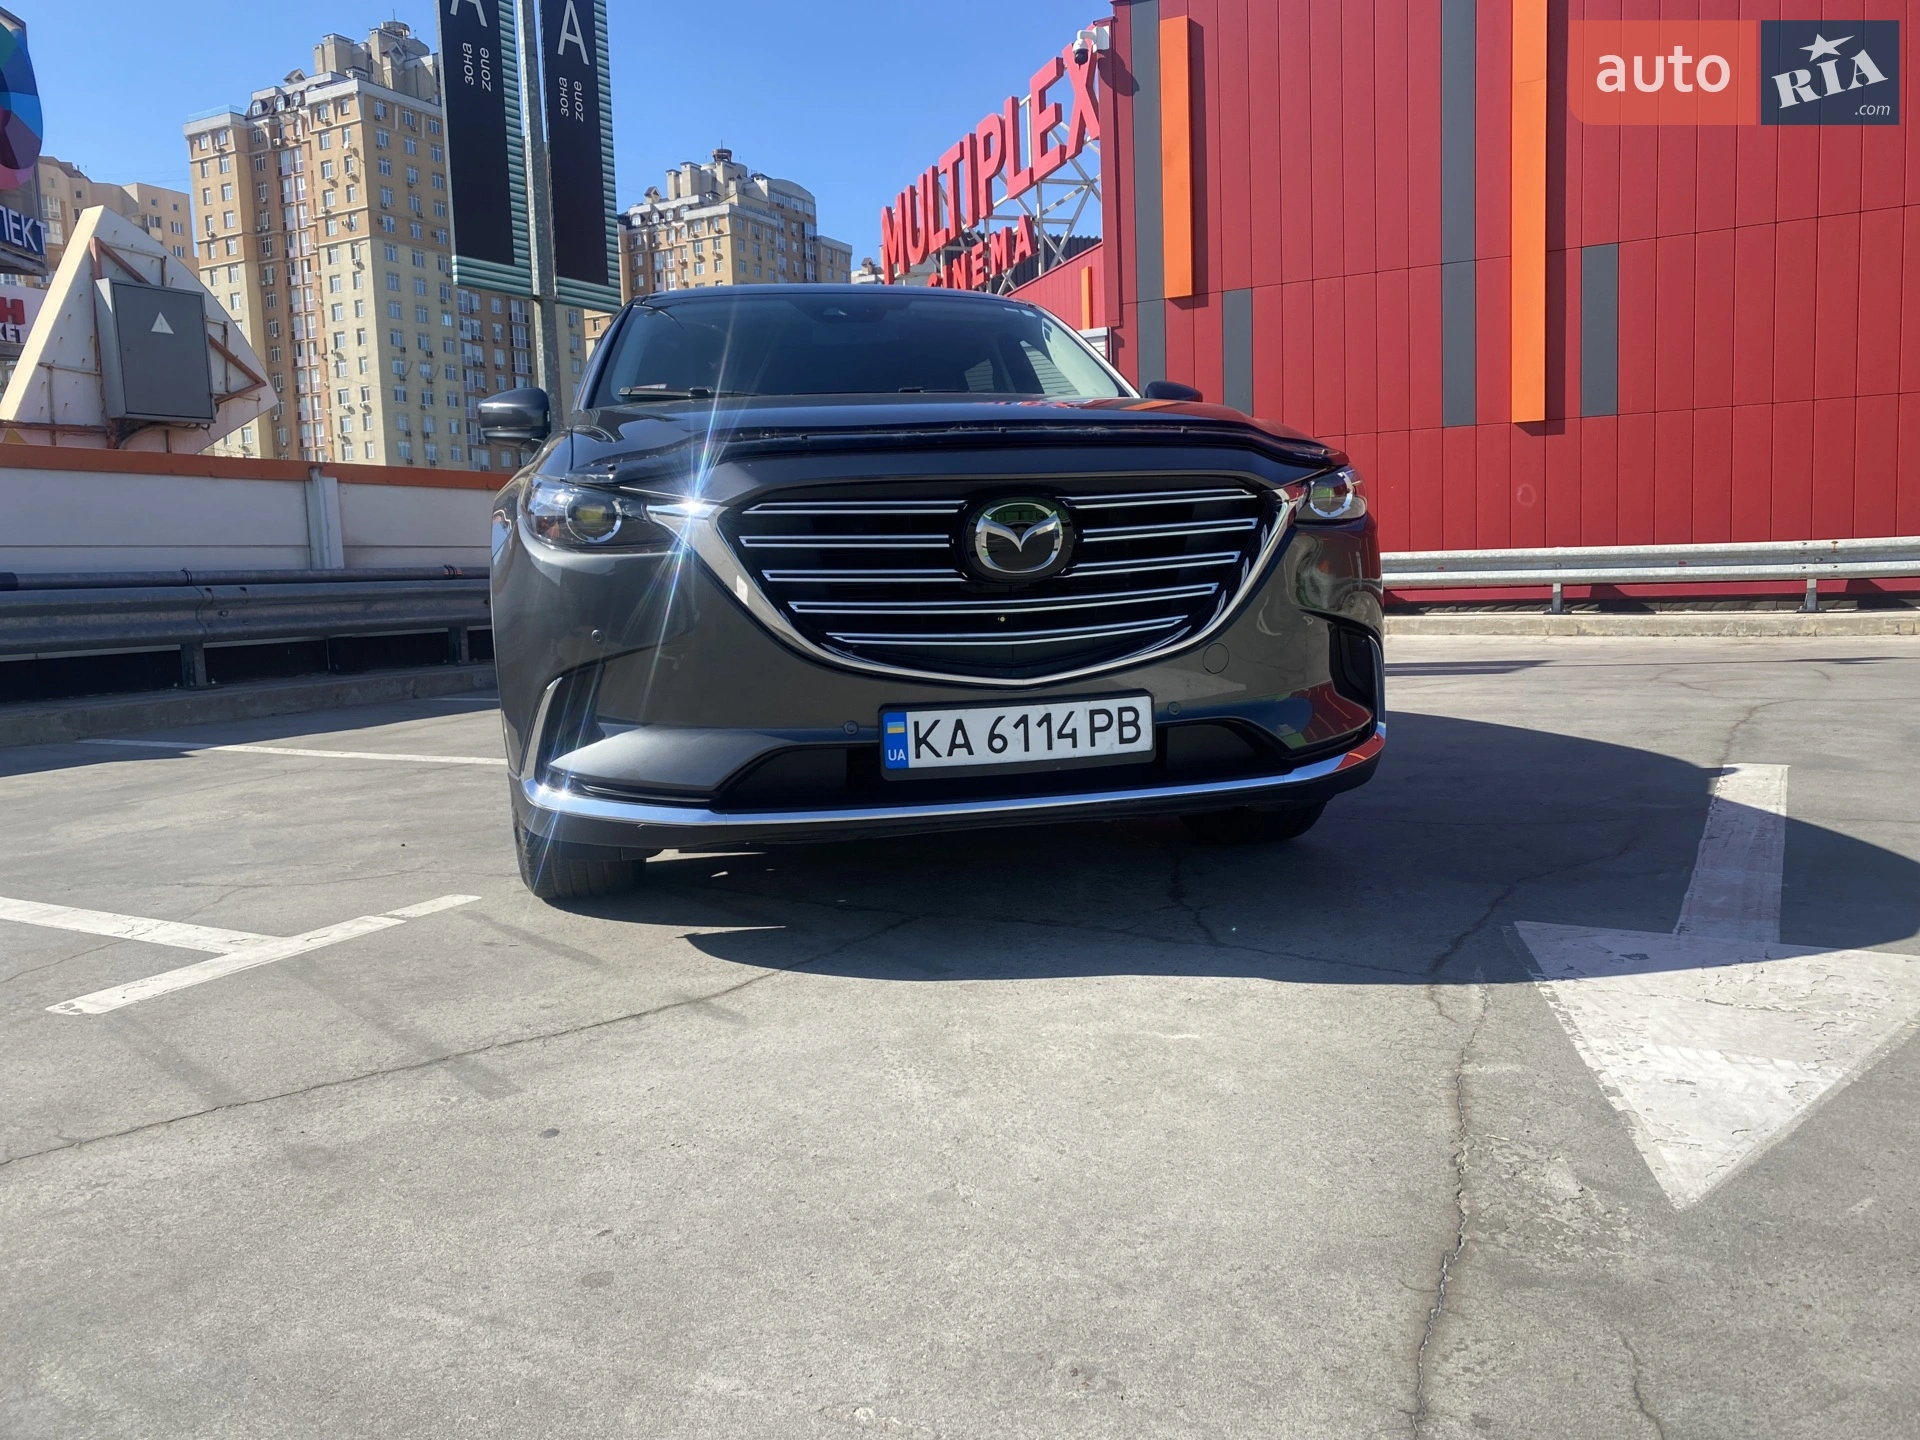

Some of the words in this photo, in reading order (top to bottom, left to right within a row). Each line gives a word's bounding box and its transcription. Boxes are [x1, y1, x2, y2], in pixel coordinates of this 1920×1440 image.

[462, 42, 475, 86] зона
[480, 47, 492, 92] zone
[558, 76, 570, 117] зона
[573, 80, 584, 122] zone
[881, 23, 1100, 285] MULTIPLEX
[887, 748, 907, 761] UA
[913, 718, 975, 760] KA
[987, 710, 1078, 754] 6114
[1088, 705, 1142, 748] PB
